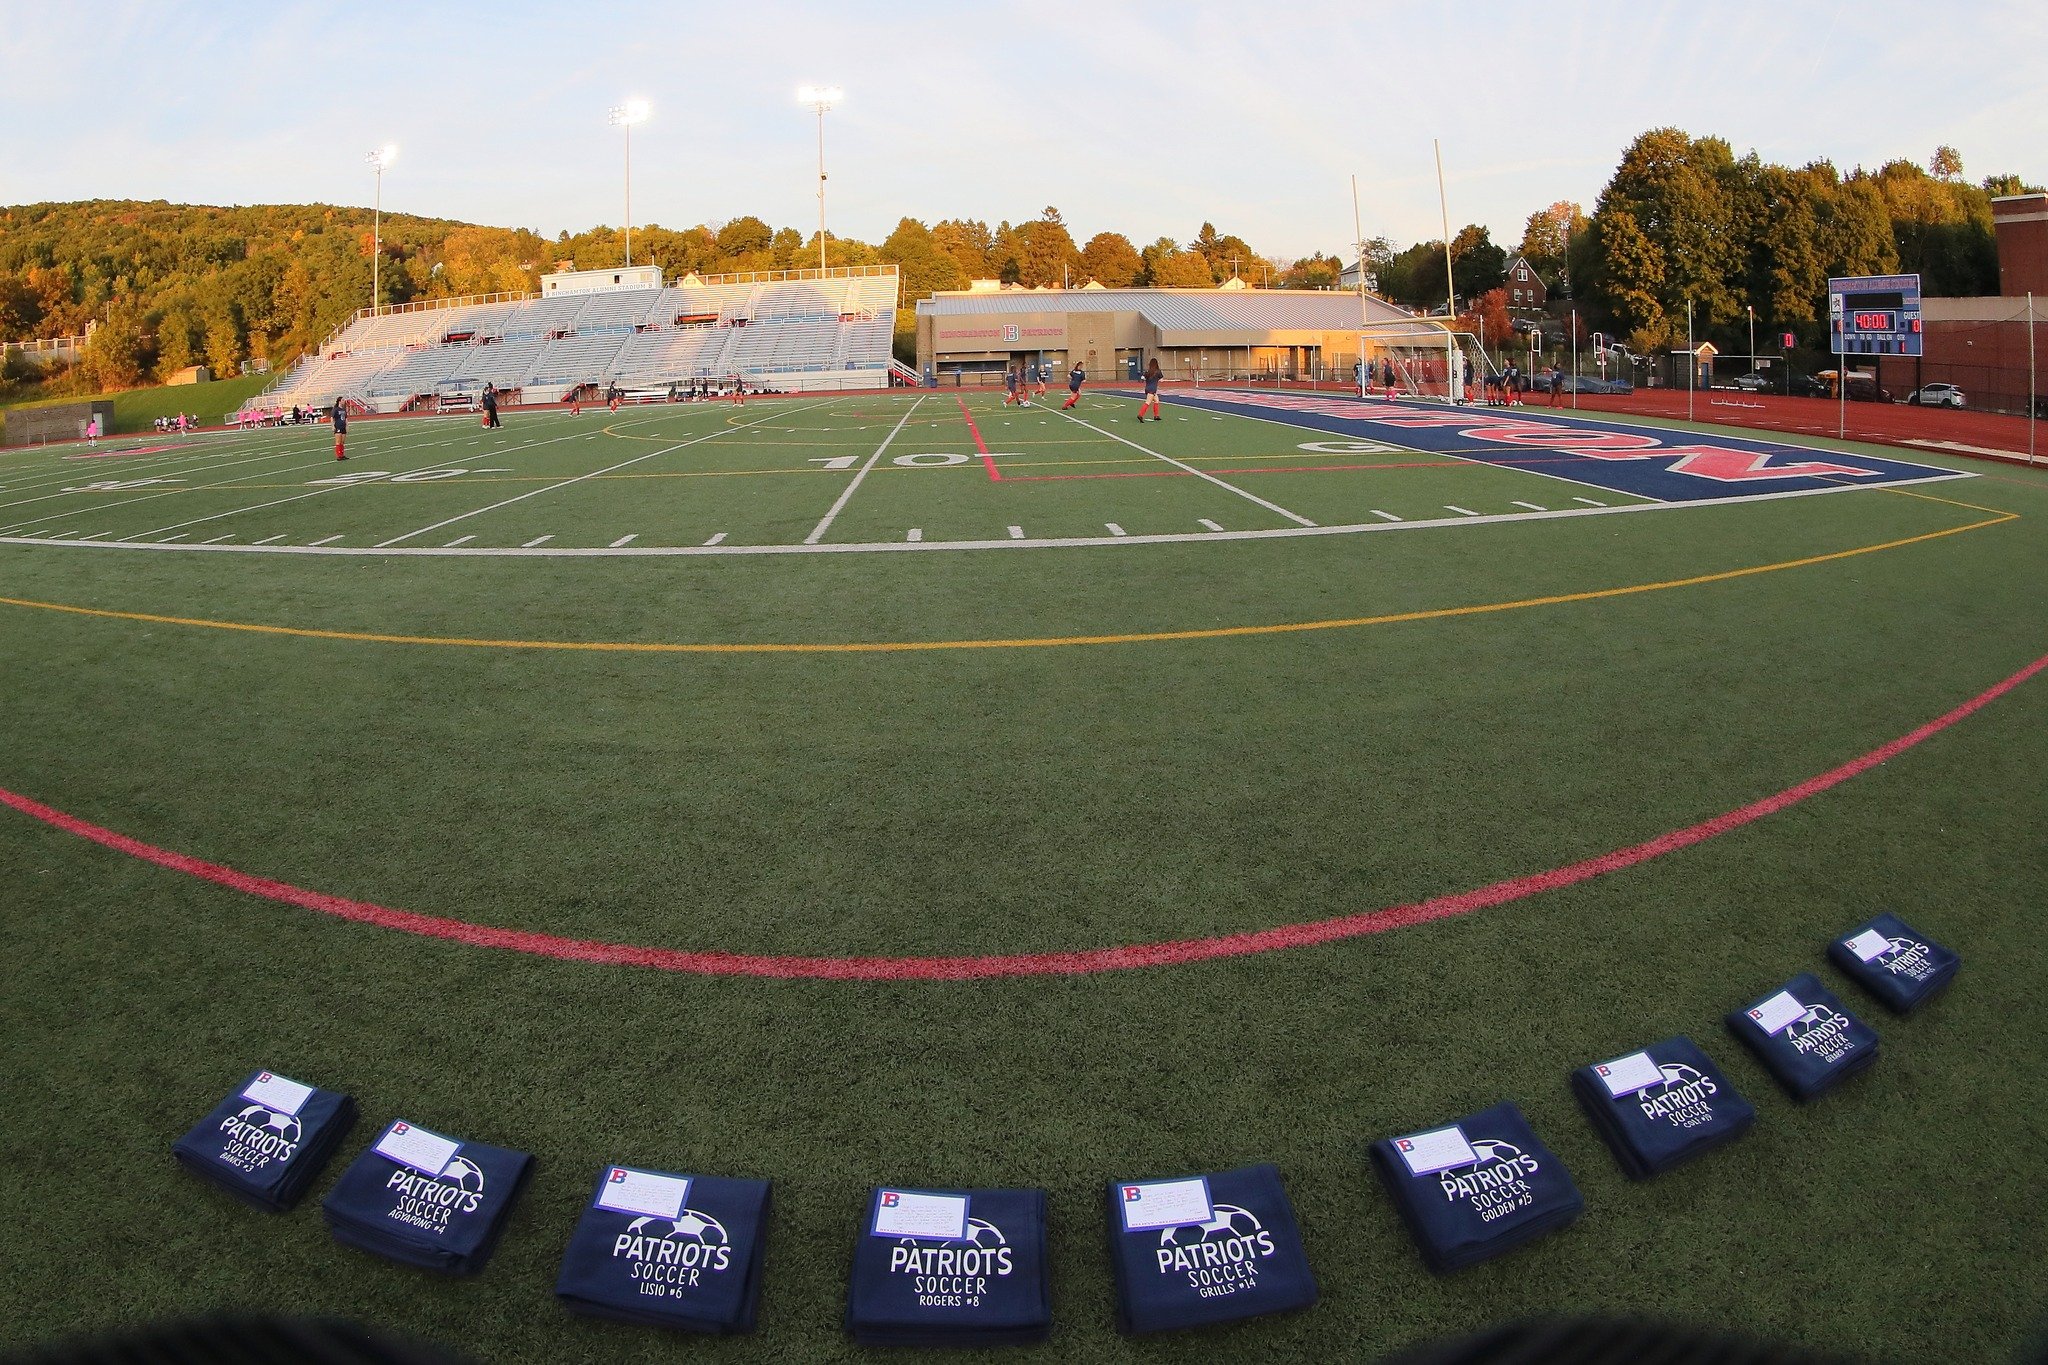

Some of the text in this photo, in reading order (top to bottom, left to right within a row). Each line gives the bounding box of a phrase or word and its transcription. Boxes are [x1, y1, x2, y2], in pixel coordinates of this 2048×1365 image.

[1002, 324, 1018, 342] B
[1884, 942, 1930, 975] PATRIOTS
[1904, 958, 1932, 977] SOCCER
[1790, 1012, 1850, 1054] PATRIOTS
[1814, 1032, 1849, 1057] SOCCER
[1640, 1076, 1717, 1120] PATRIOTS
[1668, 1101, 1712, 1126] SOCCER
[219, 1116, 297, 1163] PATRIOTS
[224, 1139, 270, 1169] SOCCER
[220, 1152, 254, 1173] BANKS #3
[386, 1170, 484, 1213] PATRIOTS
[1440, 1154, 1538, 1202] PATRIOTS
[396, 1195, 452, 1225] SOCCER
[1471, 1179, 1531, 1212] SOCCER
[1482, 1192, 1532, 1222] GOLDEN #15
[388, 1208, 445, 1235] AGYAPONG #4
[613, 1234, 732, 1270] PATRIOTS
[890, 1246, 1013, 1276] PATRIOTS
[1156, 1230, 1275, 1274] PATRIOTS
[631, 1262, 699, 1286] SOCCER
[914, 1276, 986, 1294] SOCCER
[1188, 1260, 1258, 1288] SOCCER
[1200, 1278, 1256, 1298] GRILLS #14
[640, 1282, 682, 1299] LISIO #6
[919, 1295, 980, 1307] ROGERS #8
